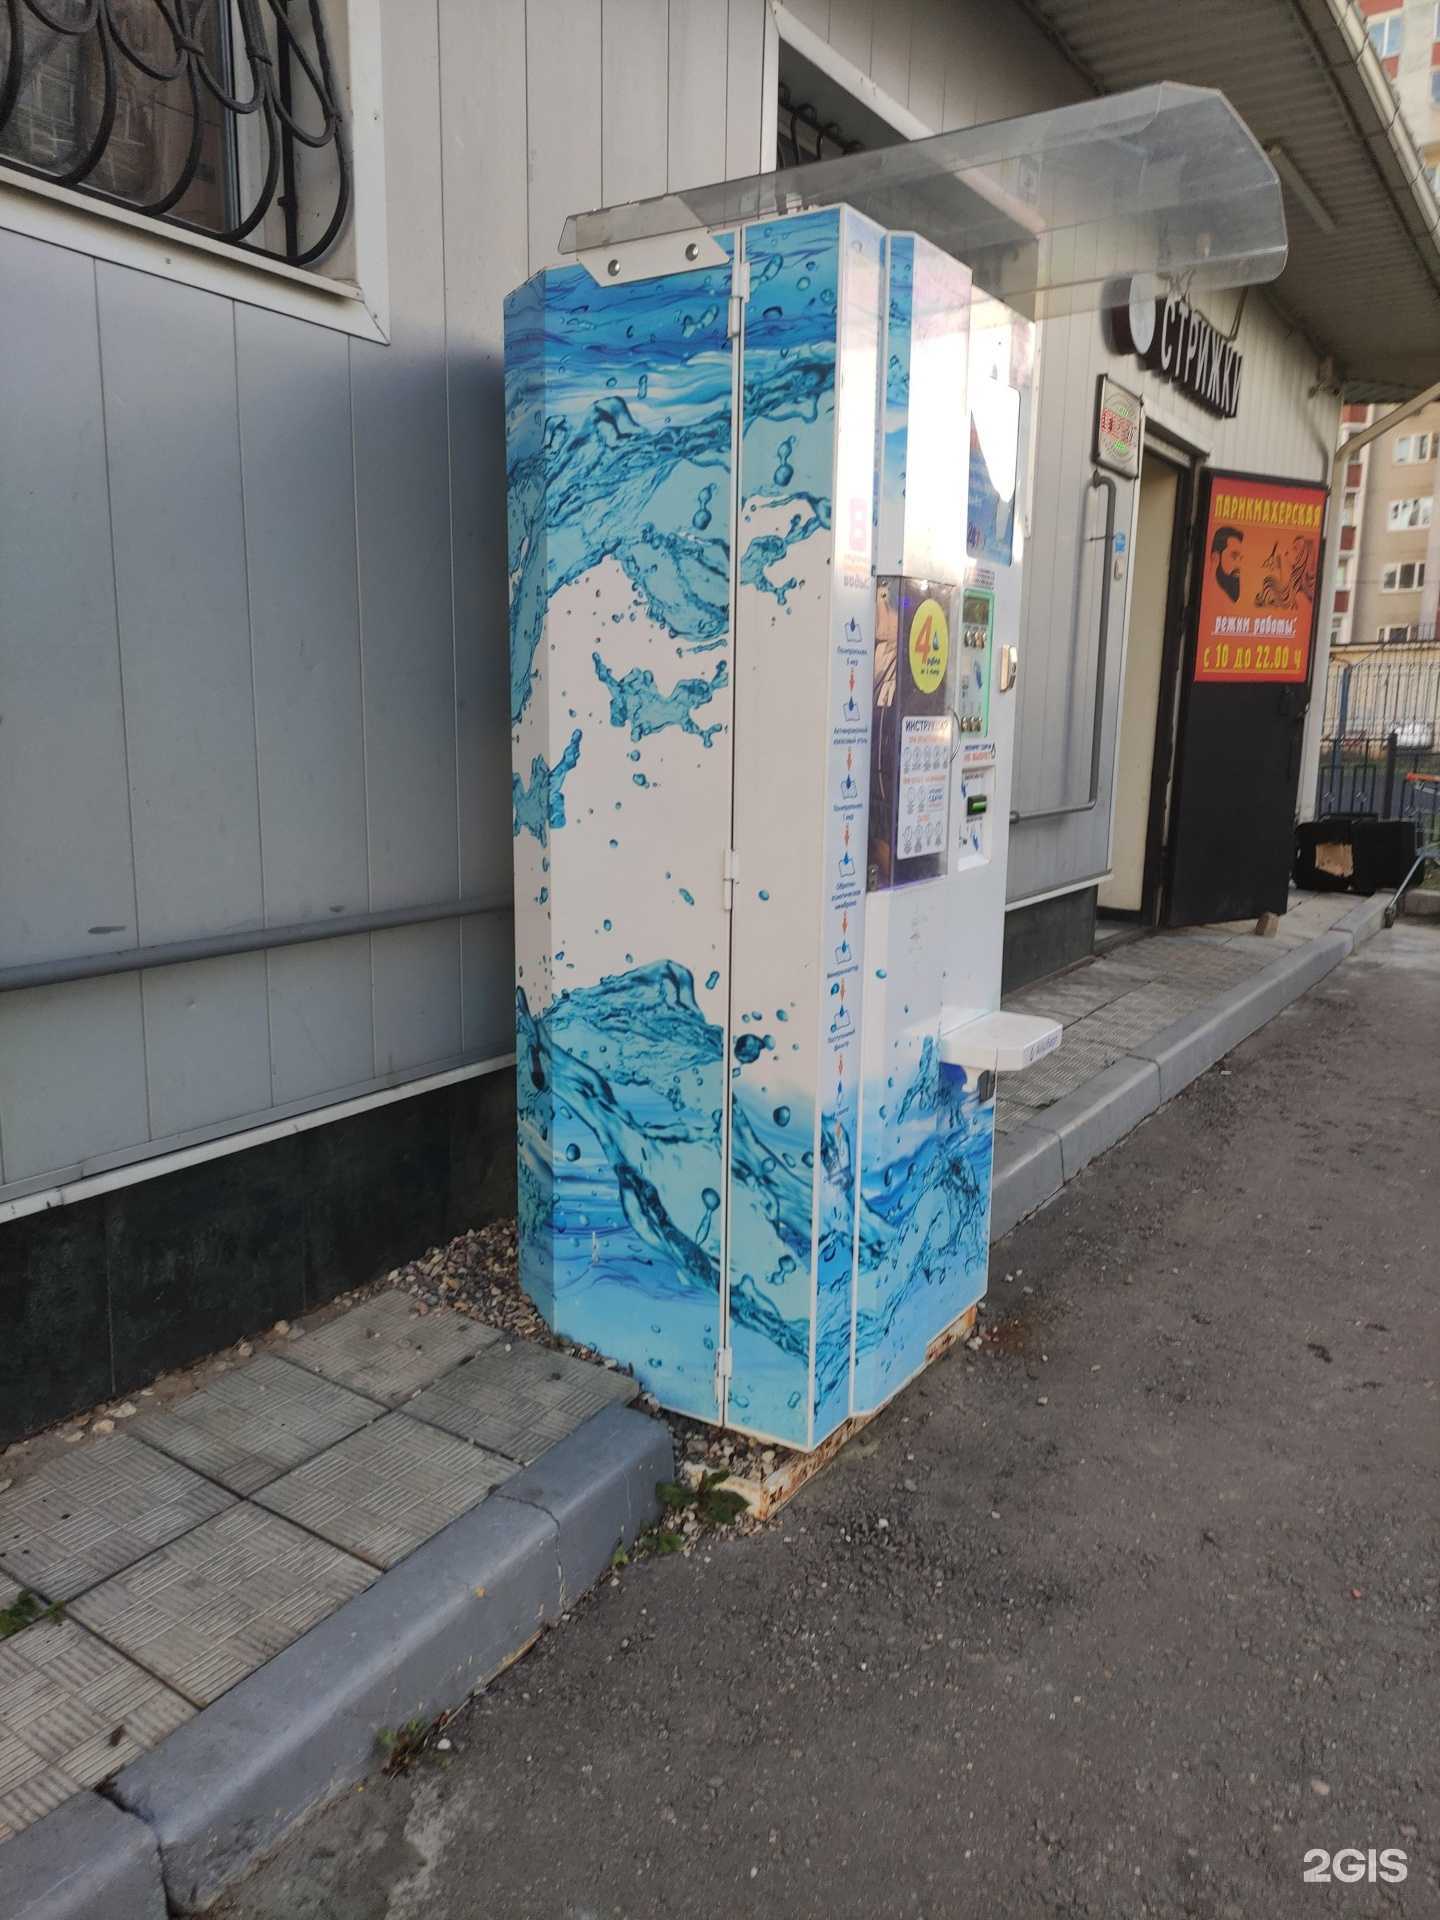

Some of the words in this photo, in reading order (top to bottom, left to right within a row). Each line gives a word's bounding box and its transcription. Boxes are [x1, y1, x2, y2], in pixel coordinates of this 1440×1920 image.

[1161, 298, 1243, 417] СТРИЖКИ
[1214, 494, 1321, 528] ПАРИКМАХЕРСКАЯ
[1215, 643, 1229, 669] 10
[1234, 647, 1252, 671] до
[904, 719, 950, 732] ИНСТРУЯ
